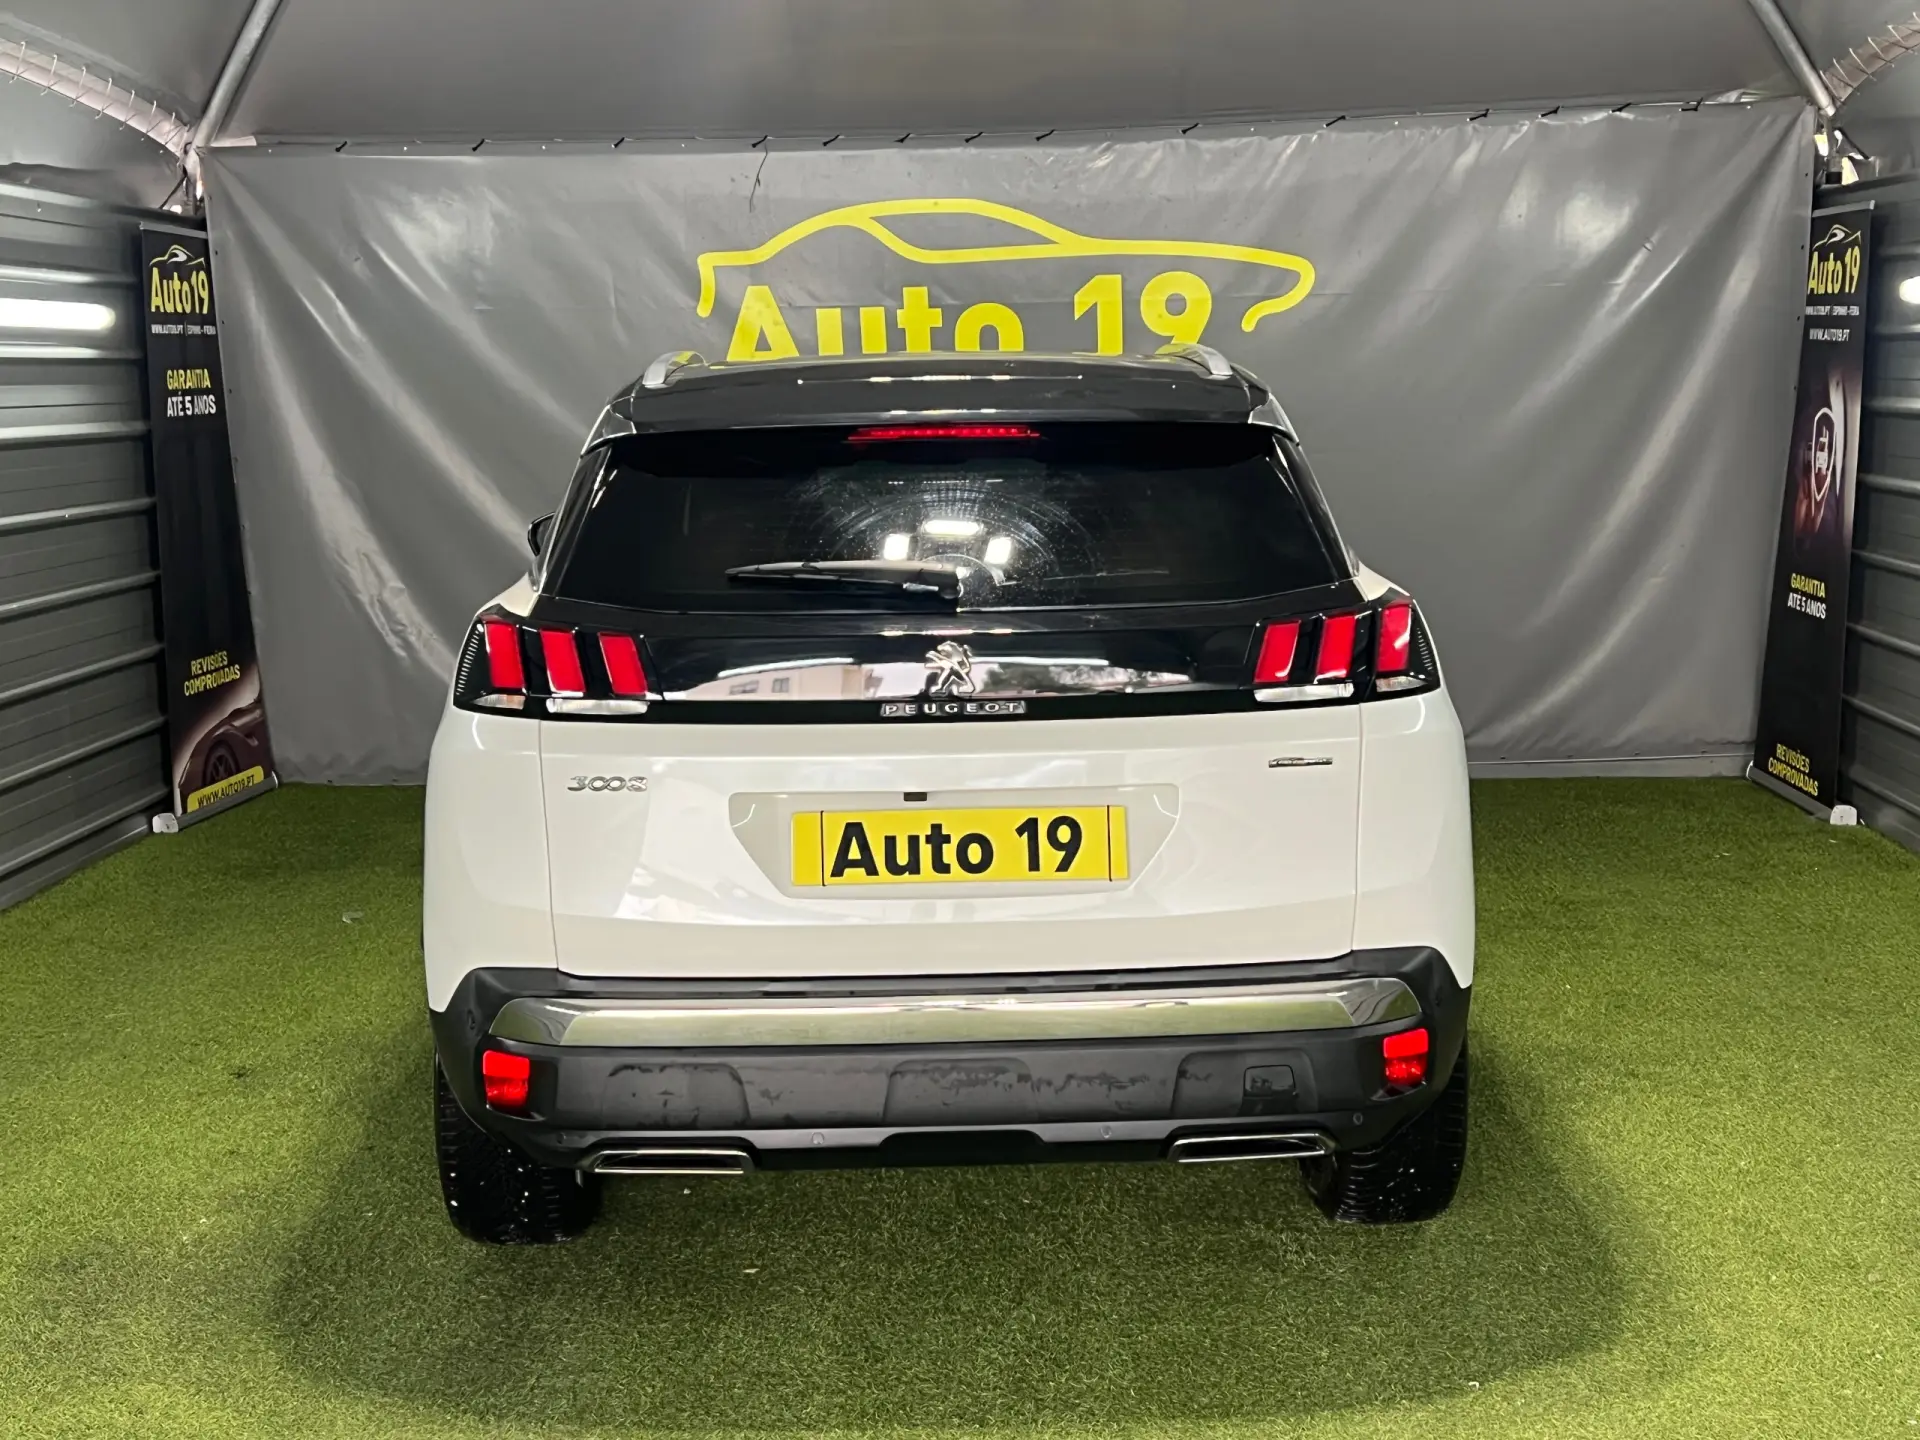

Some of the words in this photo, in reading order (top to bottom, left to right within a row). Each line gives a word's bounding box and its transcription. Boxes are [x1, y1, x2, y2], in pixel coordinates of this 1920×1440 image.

[727, 285, 1024, 361] Auto
[1074, 271, 1212, 356] 19
[167, 368, 211, 389] GARANTIA
[167, 391, 184, 417] ATÉ
[185, 395, 193, 415] 5
[194, 394, 216, 415] ANOS
[1790, 572, 1826, 598] GARANTIA
[1787, 591, 1801, 610] ATÉ
[1801, 596, 1807, 612] 5
[1805, 598, 1827, 620] ANOS
[191, 650, 229, 676] REVISÕES
[184, 664, 241, 696] COMPROVADAS
[883, 701, 1022, 716] PEUGEOT
[1776, 743, 1810, 773] REVISÕES
[197, 774, 255, 808] WWW.AUTO19.PT
[567, 775, 648, 792] 3008
[1768, 757, 1818, 796] COMPROVADAS
[830, 821, 994, 878] Auto
[1015, 815, 1083, 873] 19
